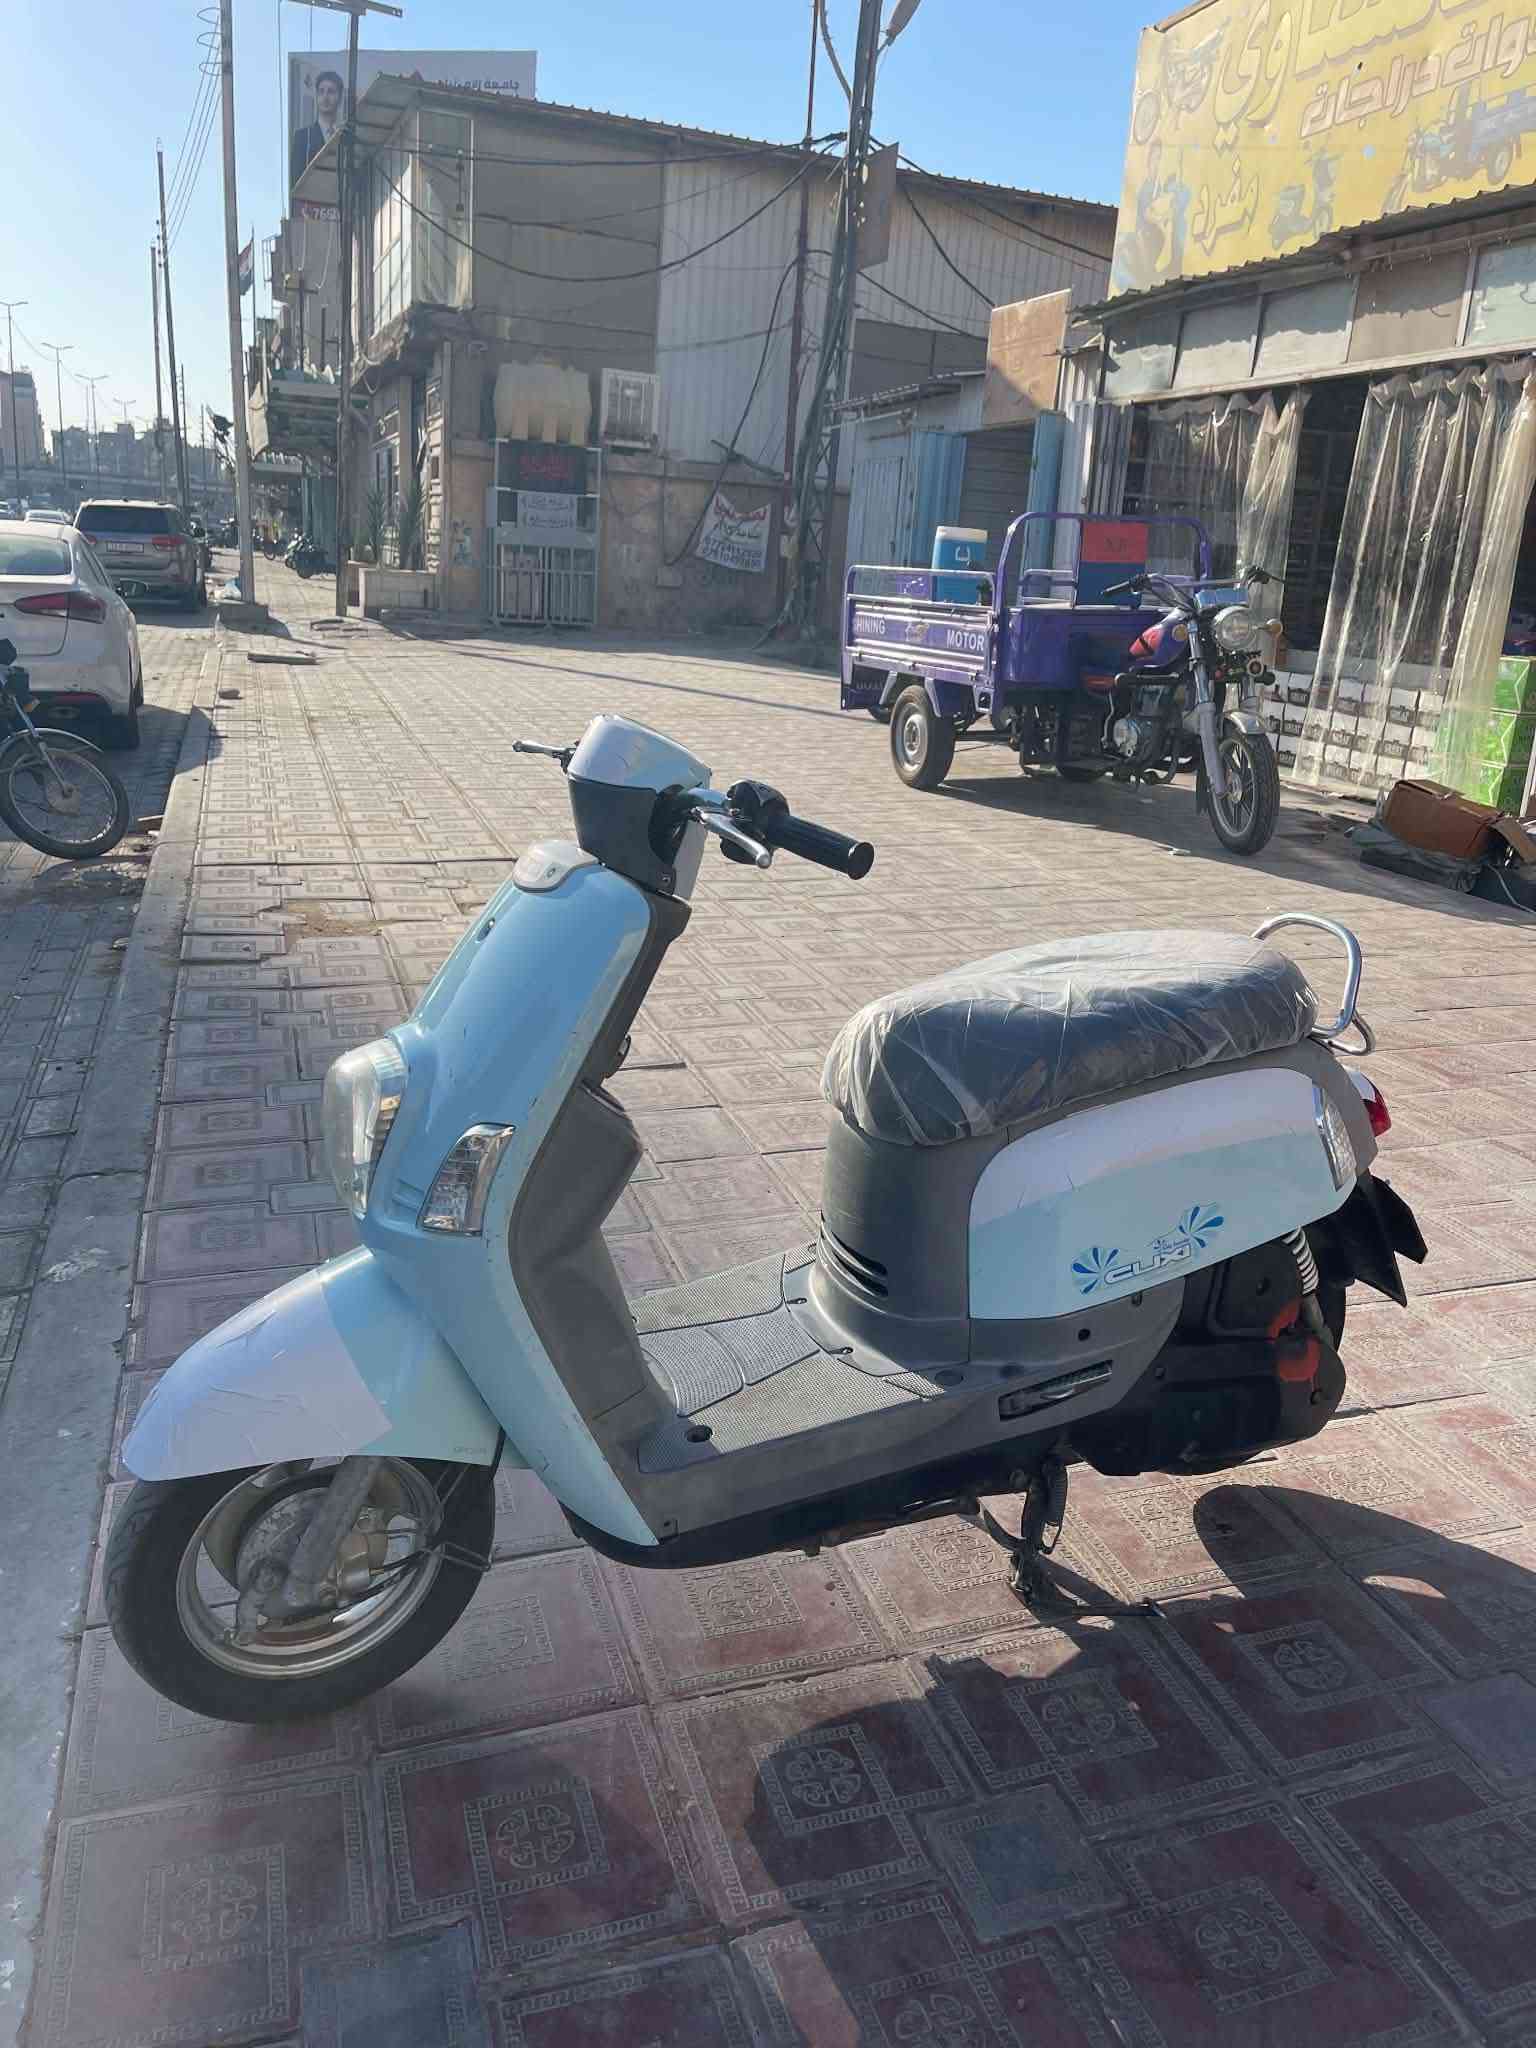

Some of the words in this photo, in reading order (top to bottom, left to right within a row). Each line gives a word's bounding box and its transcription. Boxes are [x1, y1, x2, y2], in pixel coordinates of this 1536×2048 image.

[1299, 53, 1442, 140] دراجات
[947, 629, 985, 651] MOTOR
[1104, 1243, 1191, 1284] CUXI
